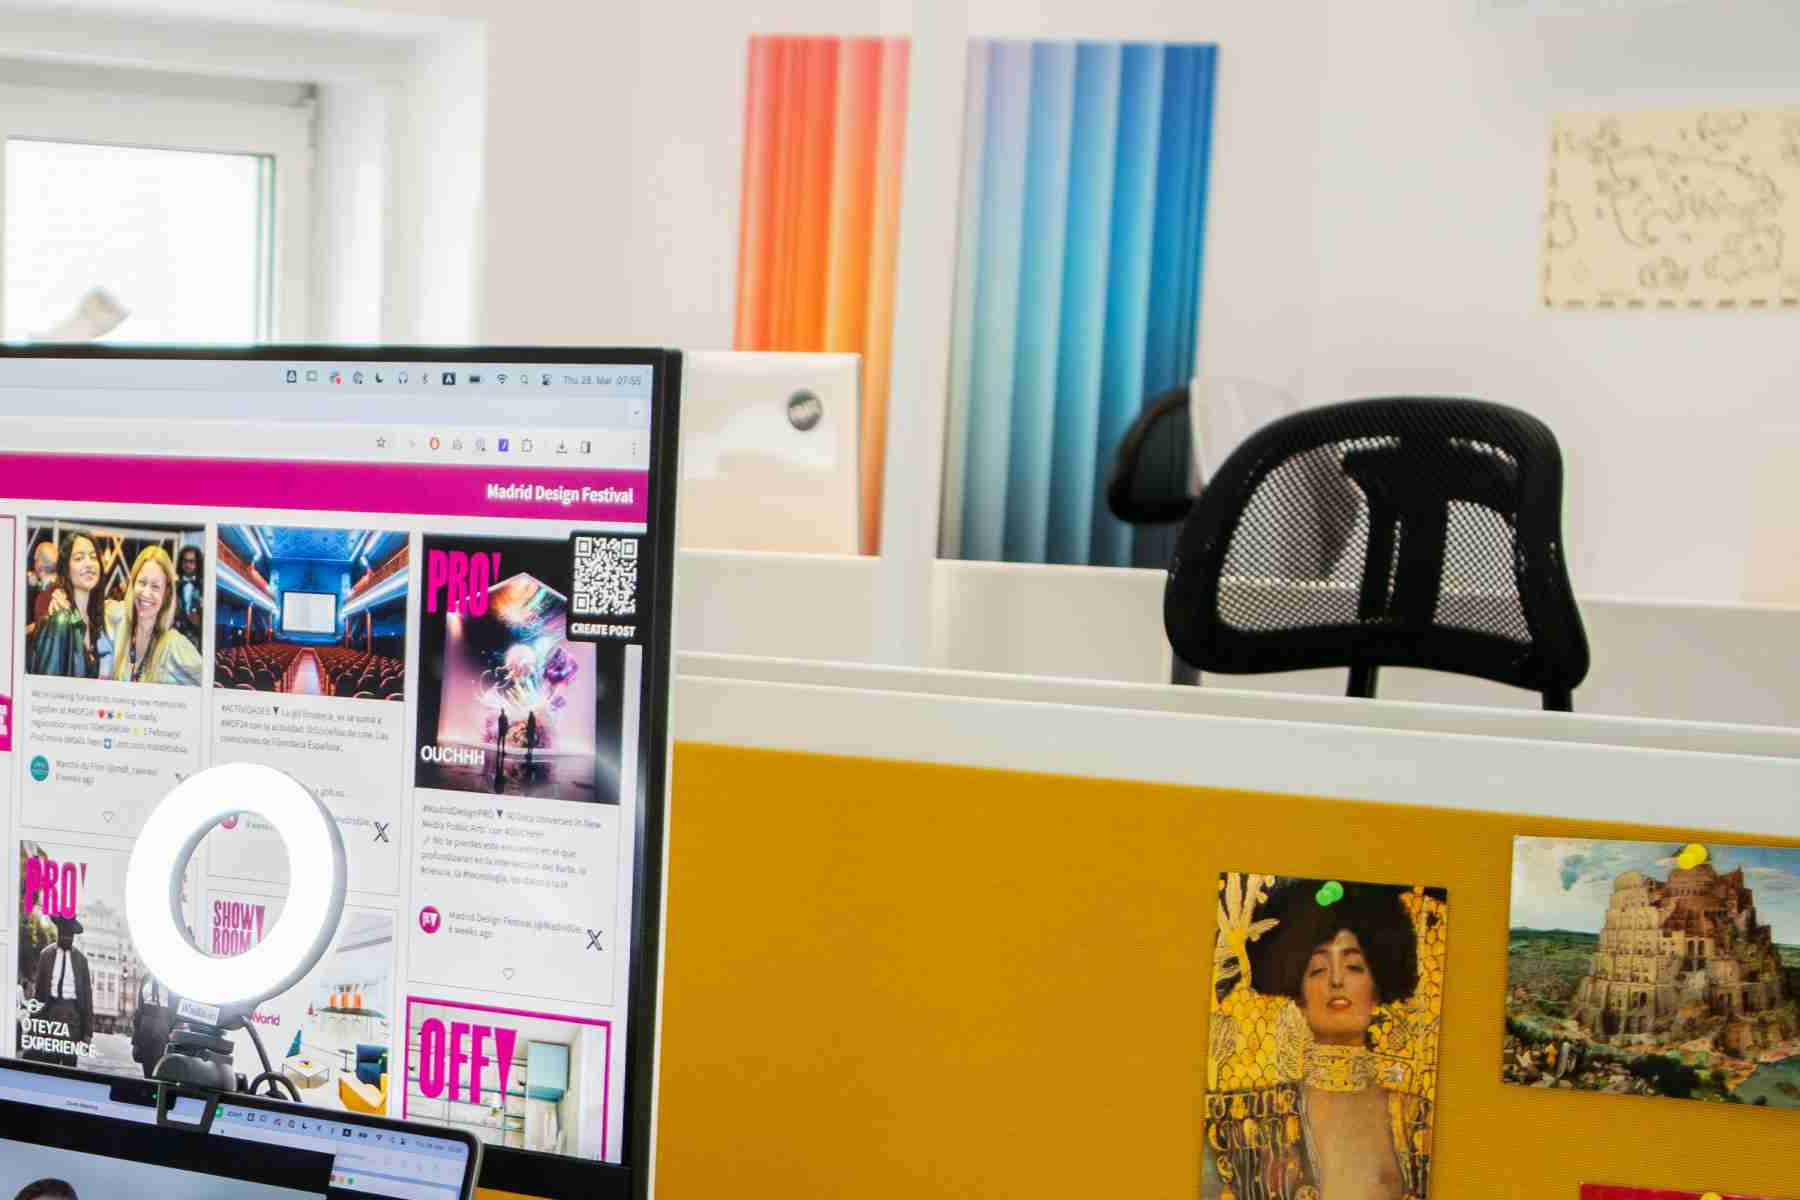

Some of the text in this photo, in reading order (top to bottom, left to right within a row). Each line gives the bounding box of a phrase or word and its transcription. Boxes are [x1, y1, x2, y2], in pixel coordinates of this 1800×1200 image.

[487, 484, 634, 505] Madrid Design Festival
[571, 623, 636, 639] CREATE POST
[421, 745, 485, 765] OUCHHH
[213, 900, 253, 930] SHOW
[21, 1034, 97, 1056] EXPERIENCE
